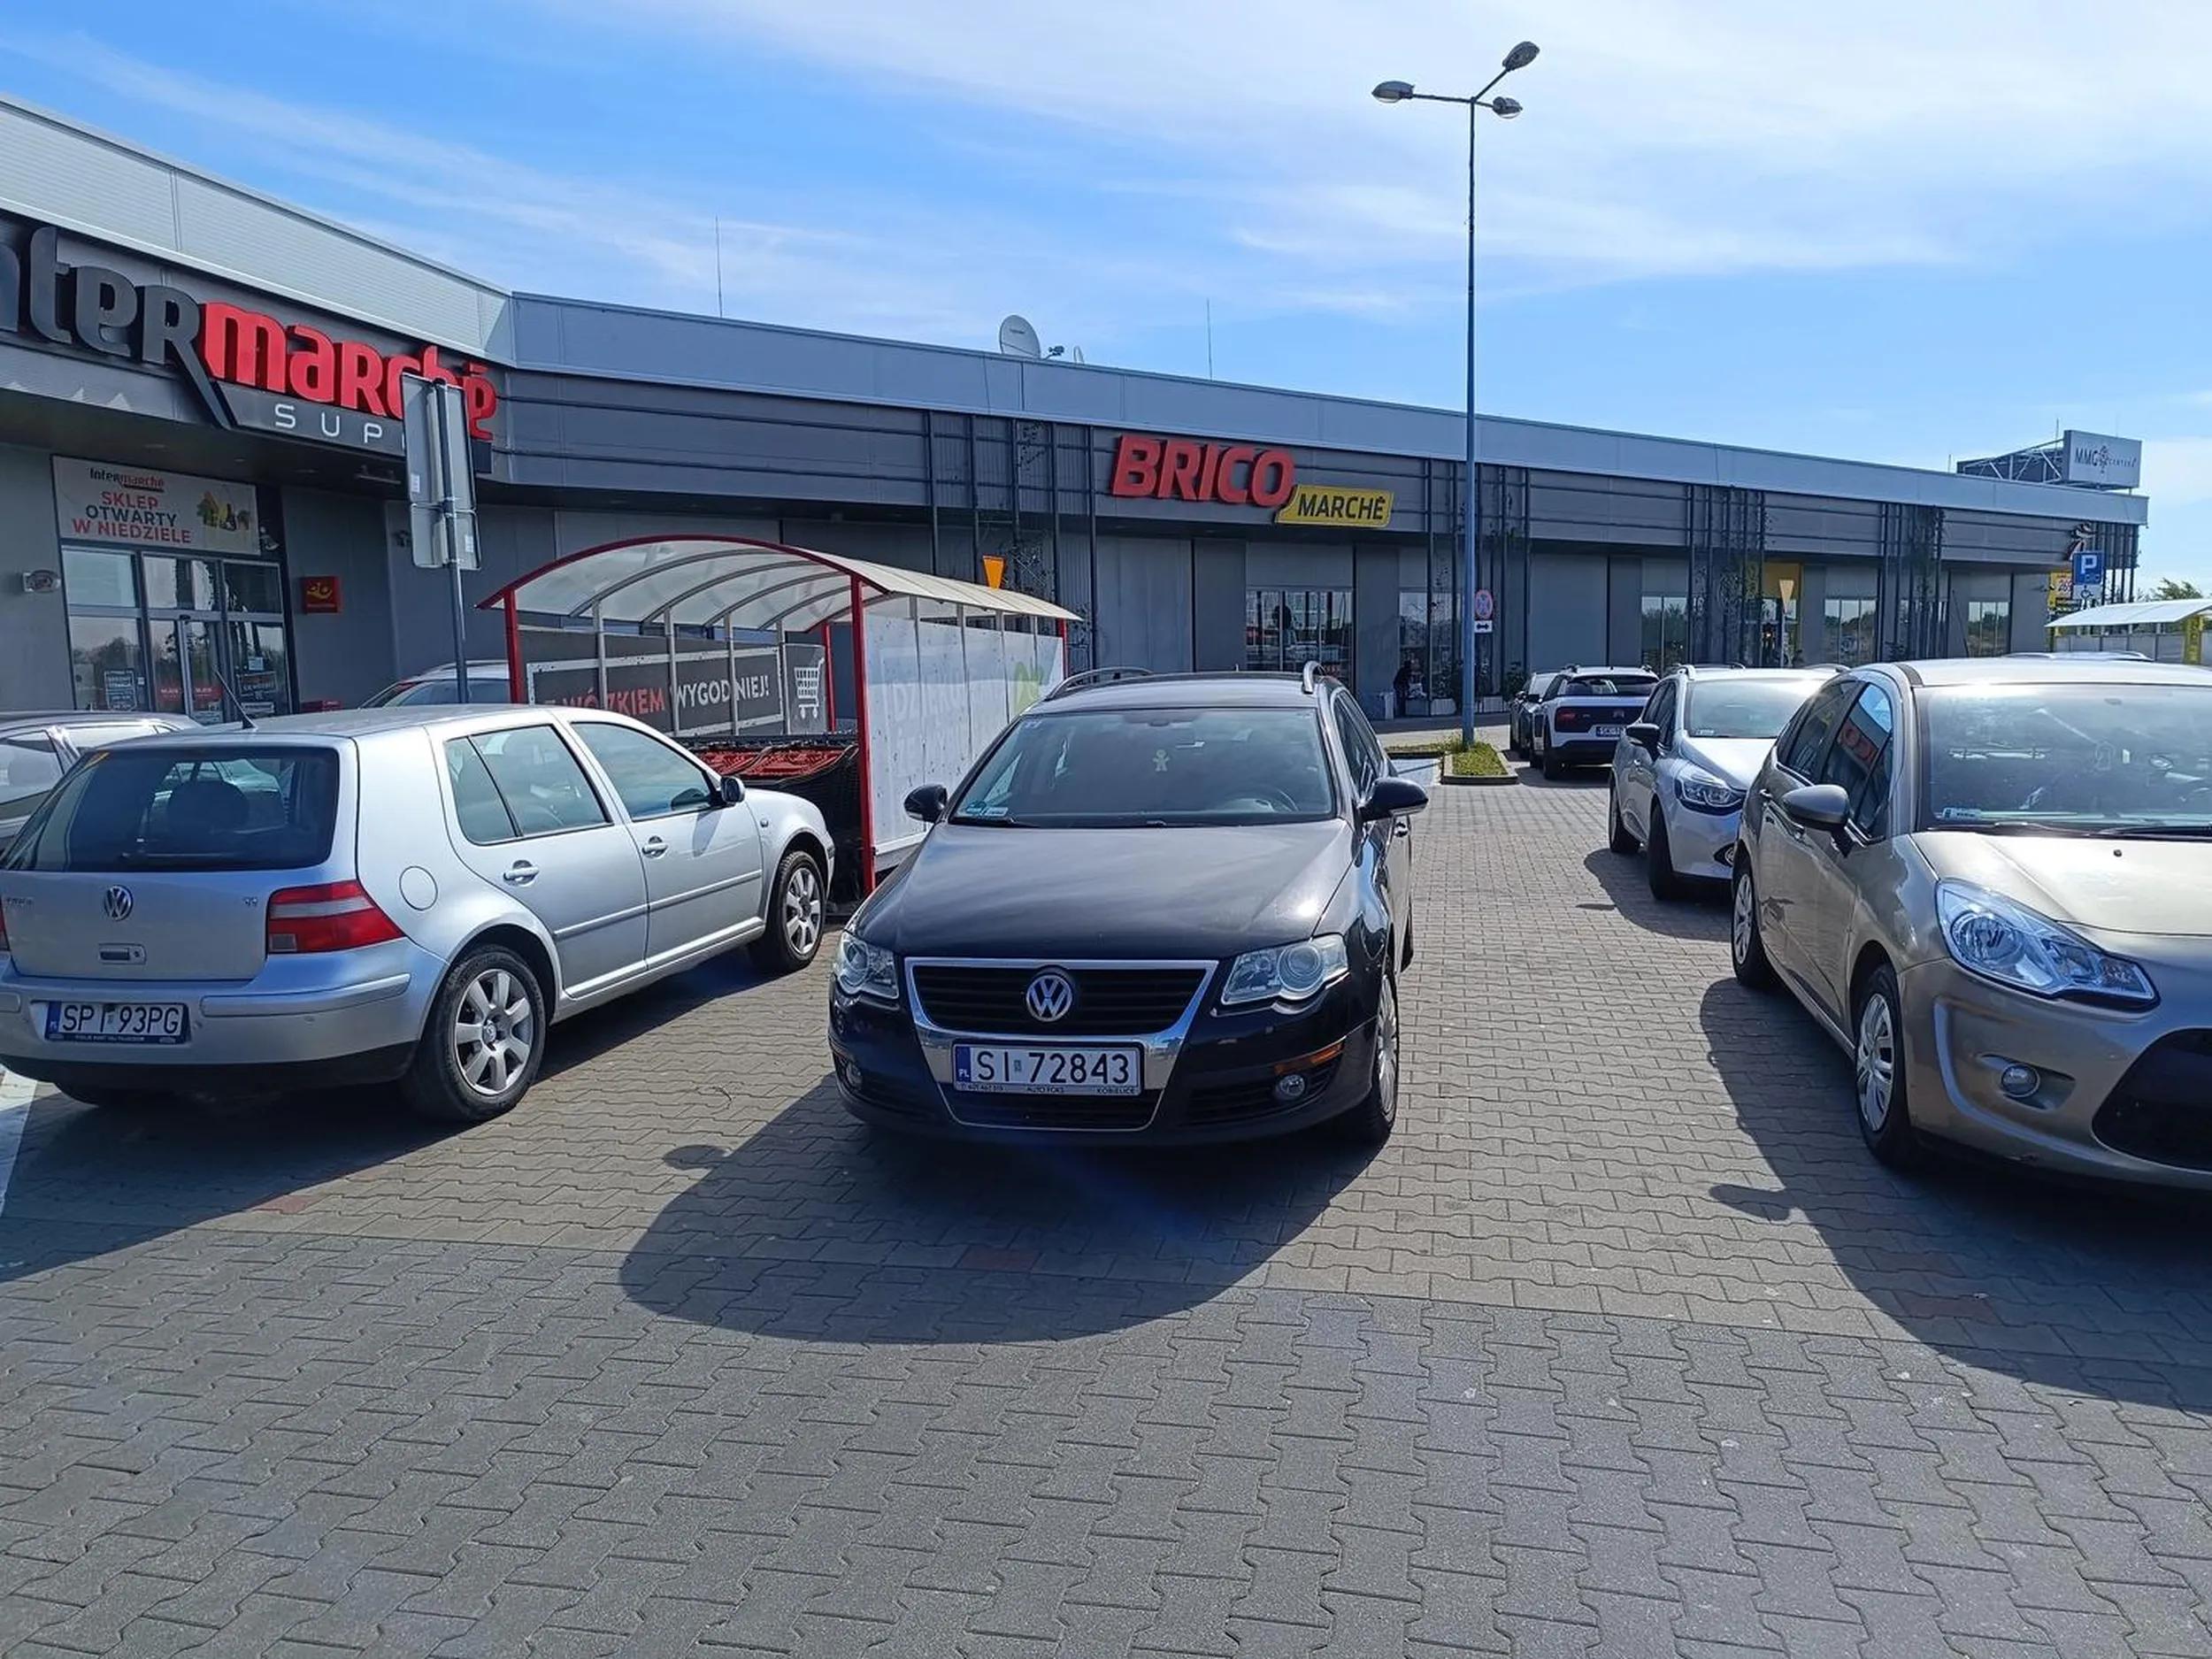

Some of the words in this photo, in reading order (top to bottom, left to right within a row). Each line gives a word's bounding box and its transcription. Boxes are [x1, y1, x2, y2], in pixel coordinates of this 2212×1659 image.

[275, 404, 405, 450] SUP
[1113, 435, 1295, 507] BRICO
[101, 491, 159, 511] SKLEP
[85, 504, 178, 527] OTWARTY
[72, 518, 91, 533] W
[97, 521, 192, 543] NIEDZIELE
[2081, 555, 2098, 574] P
[119, 1006, 180, 1034] 93PG
[958, 1068, 970, 1079] PL
[977, 1051, 1010, 1082] SI
[1029, 1052, 1130, 1085] 72843
